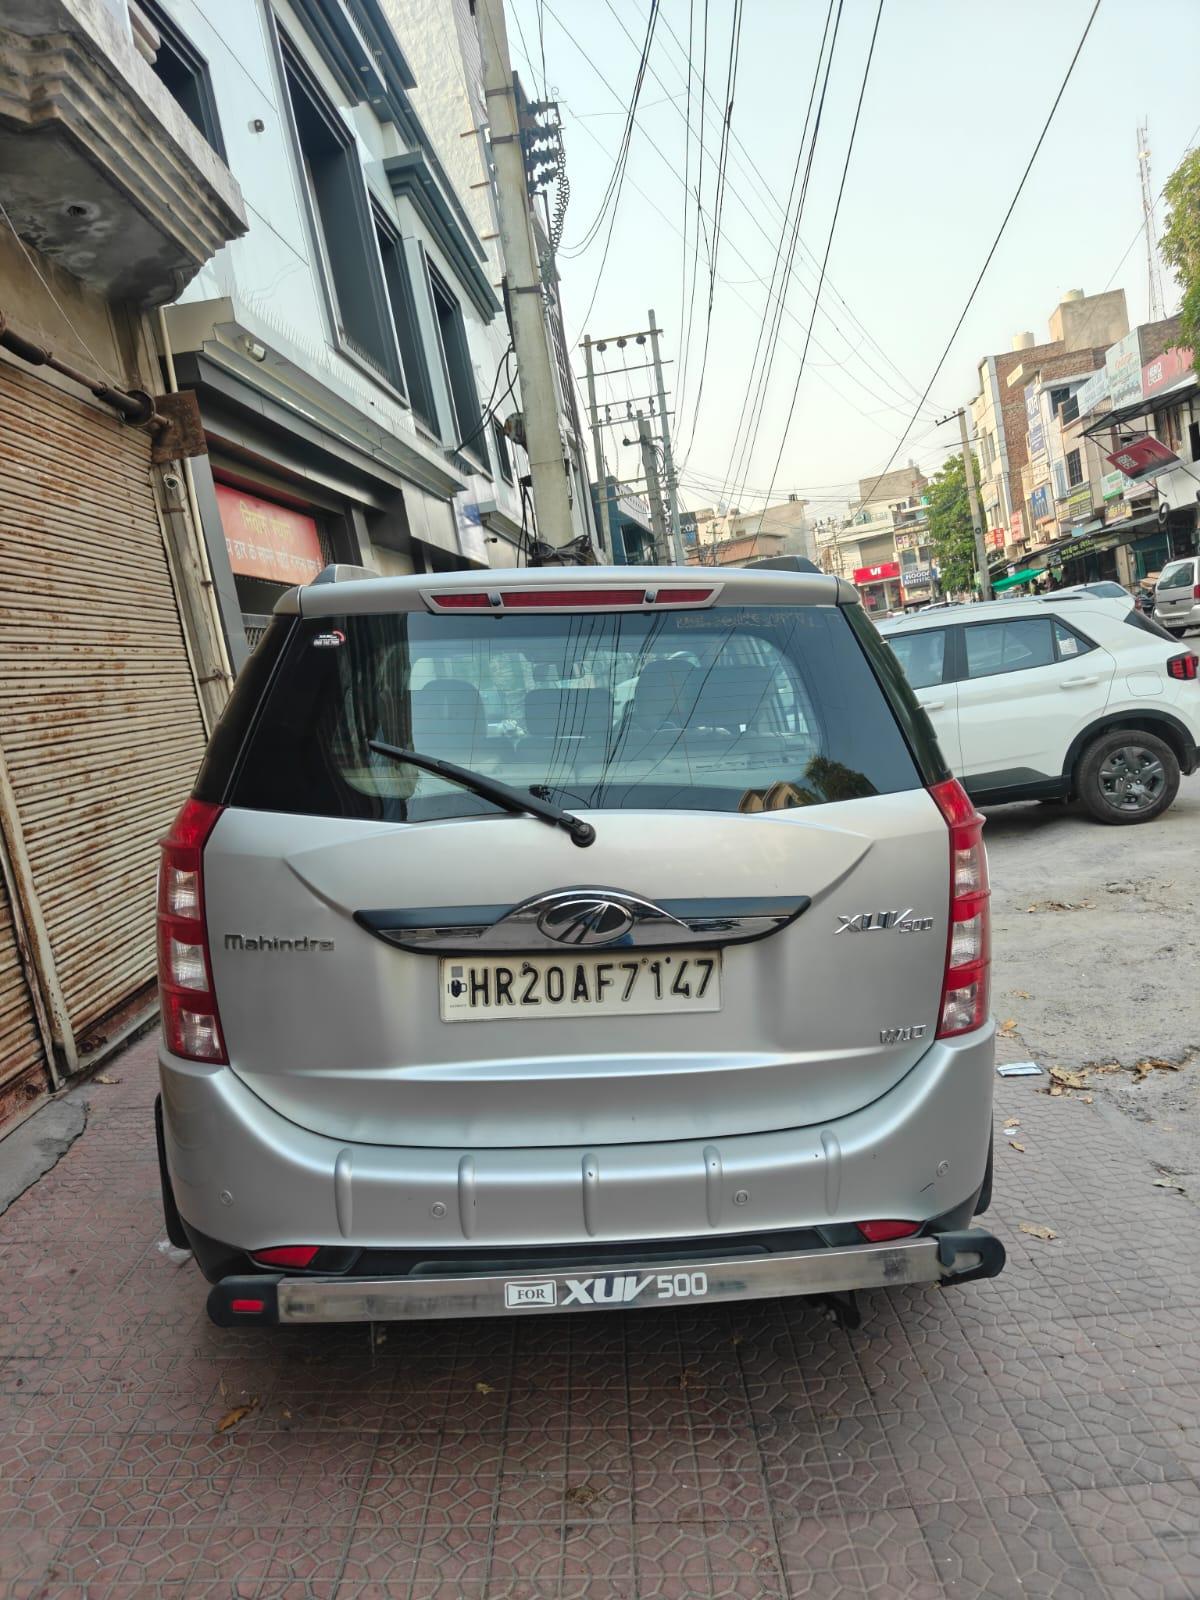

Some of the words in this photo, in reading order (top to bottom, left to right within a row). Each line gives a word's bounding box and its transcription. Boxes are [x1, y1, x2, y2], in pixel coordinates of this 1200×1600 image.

[224, 934, 335, 952] Mahindra
[468, 958, 714, 1008] HR20AF7147
[517, 1287, 546, 1301] FOR
